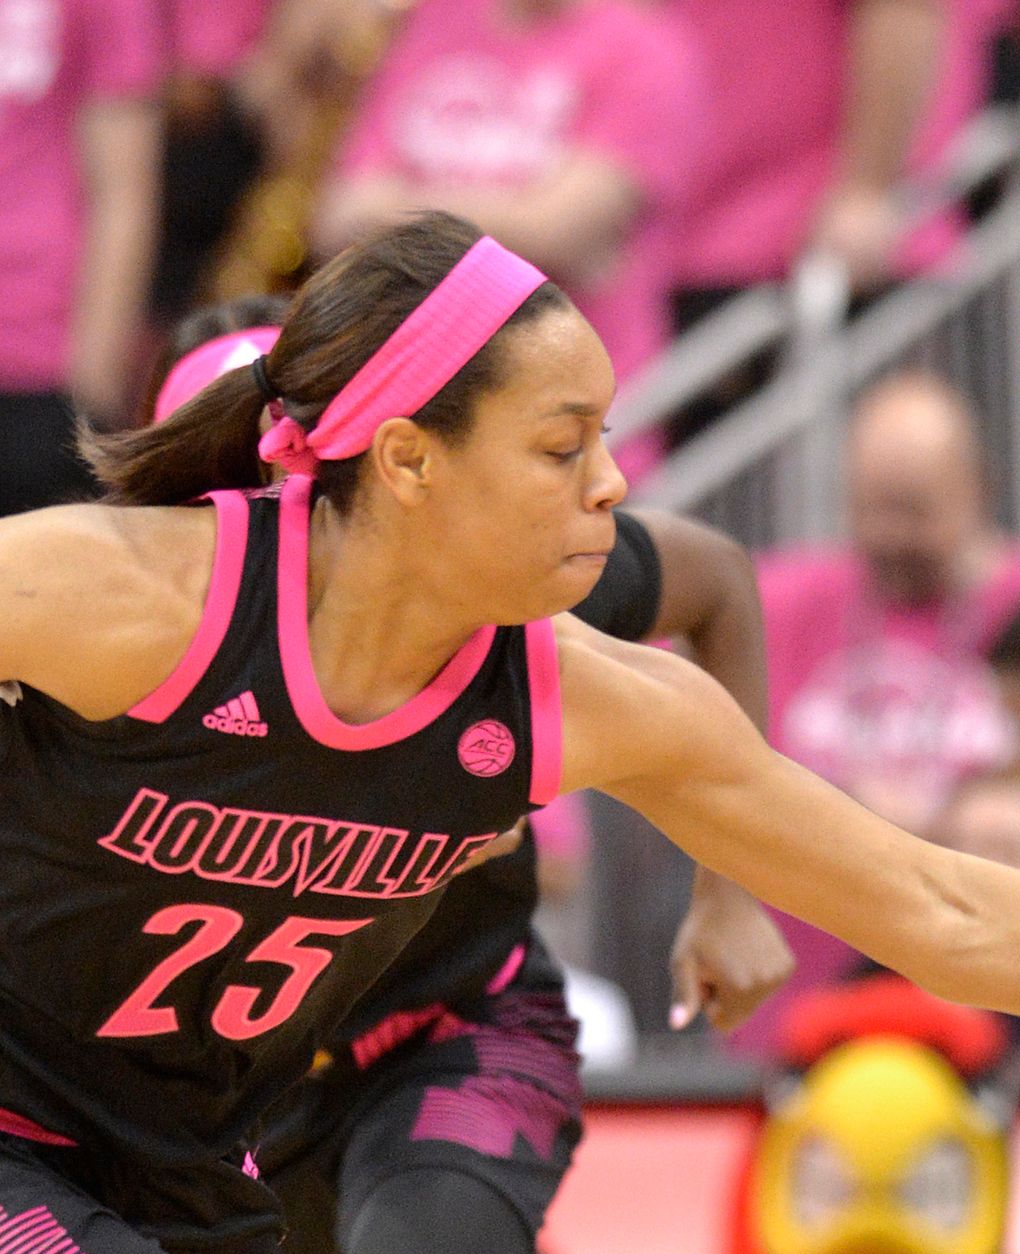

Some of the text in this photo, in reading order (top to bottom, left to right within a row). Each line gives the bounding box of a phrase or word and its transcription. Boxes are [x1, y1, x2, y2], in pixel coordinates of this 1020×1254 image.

[202, 713, 269, 738] adidas
[468, 738, 510, 756] ACC
[95, 903, 377, 1041] 25
